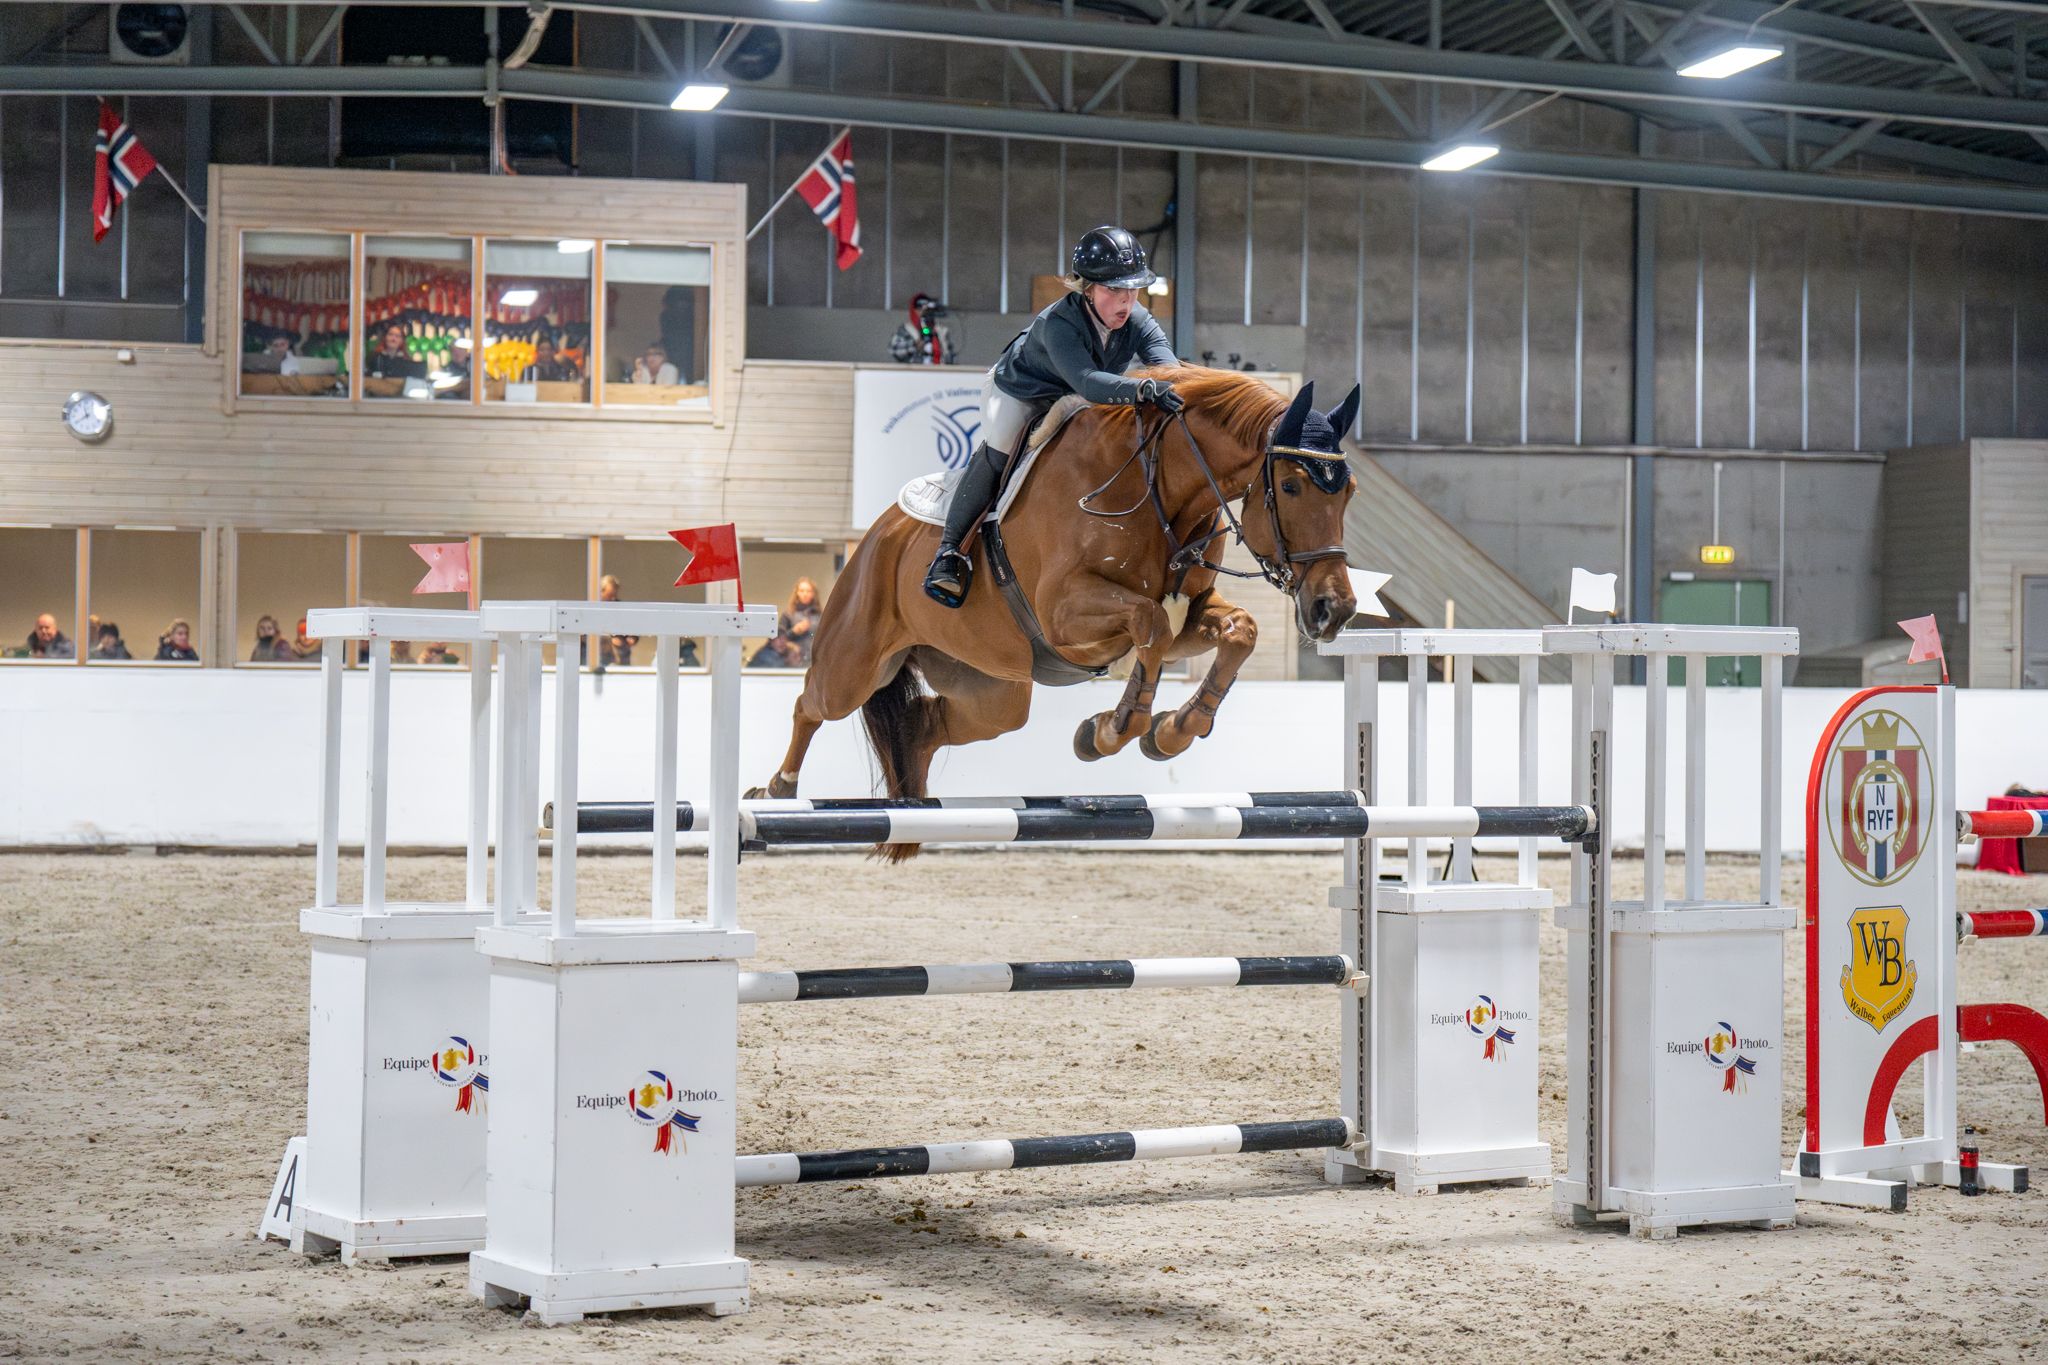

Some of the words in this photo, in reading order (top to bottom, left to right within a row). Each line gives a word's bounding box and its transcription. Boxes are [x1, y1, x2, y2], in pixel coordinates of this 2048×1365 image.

[1876, 785, 1885, 806] N
[1867, 809, 1894, 831] RYF
[1856, 920, 1902, 987] WB
[1849, 998, 1876, 1023] Walber
[1882, 987, 1914, 1023] Equestrian
[1431, 1013, 1465, 1026] Equipe
[1666, 1040, 1703, 1055] Equipe
[383, 1056, 430, 1072] Equipe
[478, 1054, 489, 1067] P
[576, 1093, 626, 1111] Equipe
[273, 1153, 298, 1223] A
